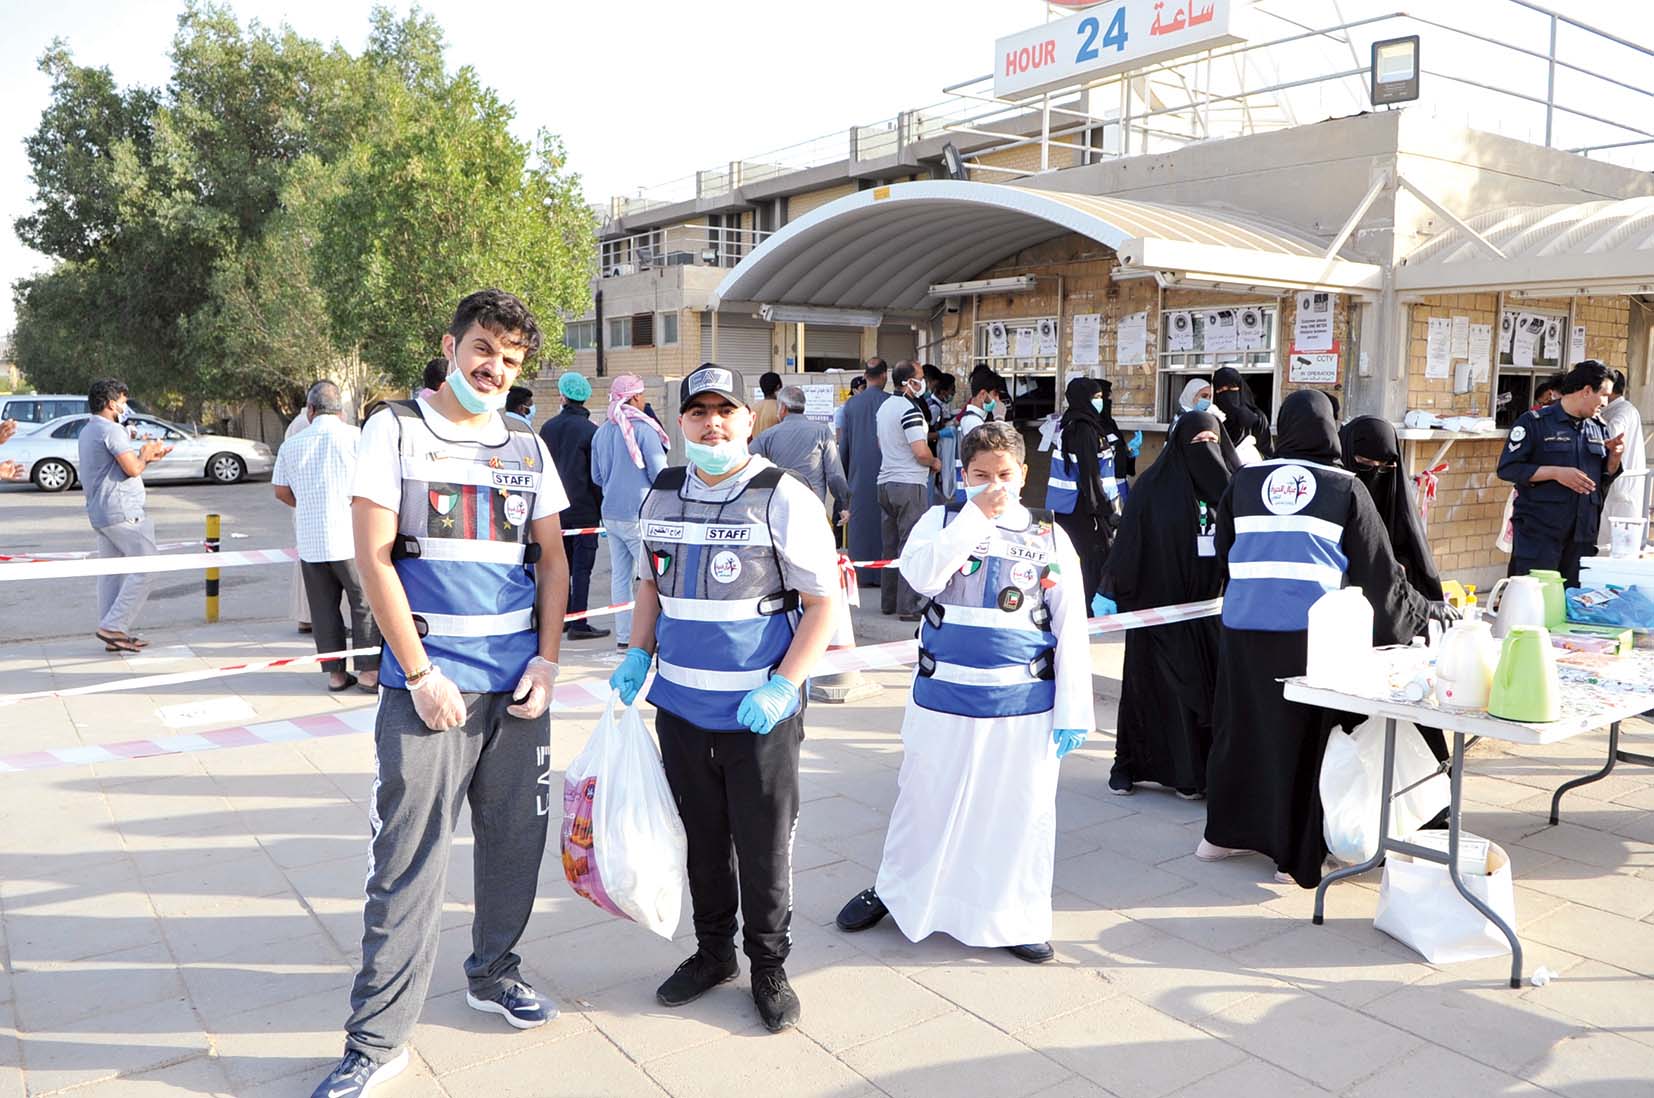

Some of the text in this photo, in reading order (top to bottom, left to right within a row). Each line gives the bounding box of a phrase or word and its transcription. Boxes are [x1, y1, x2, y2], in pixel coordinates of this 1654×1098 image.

[1150, 0, 1215, 36] ساعة
[1075, 6, 1129, 65] 24
[1005, 40, 1056, 77] HOUR
[495, 474, 531, 486] STAFF
[709, 529, 748, 539] STAFF
[1009, 547, 1046, 561] STAFF
